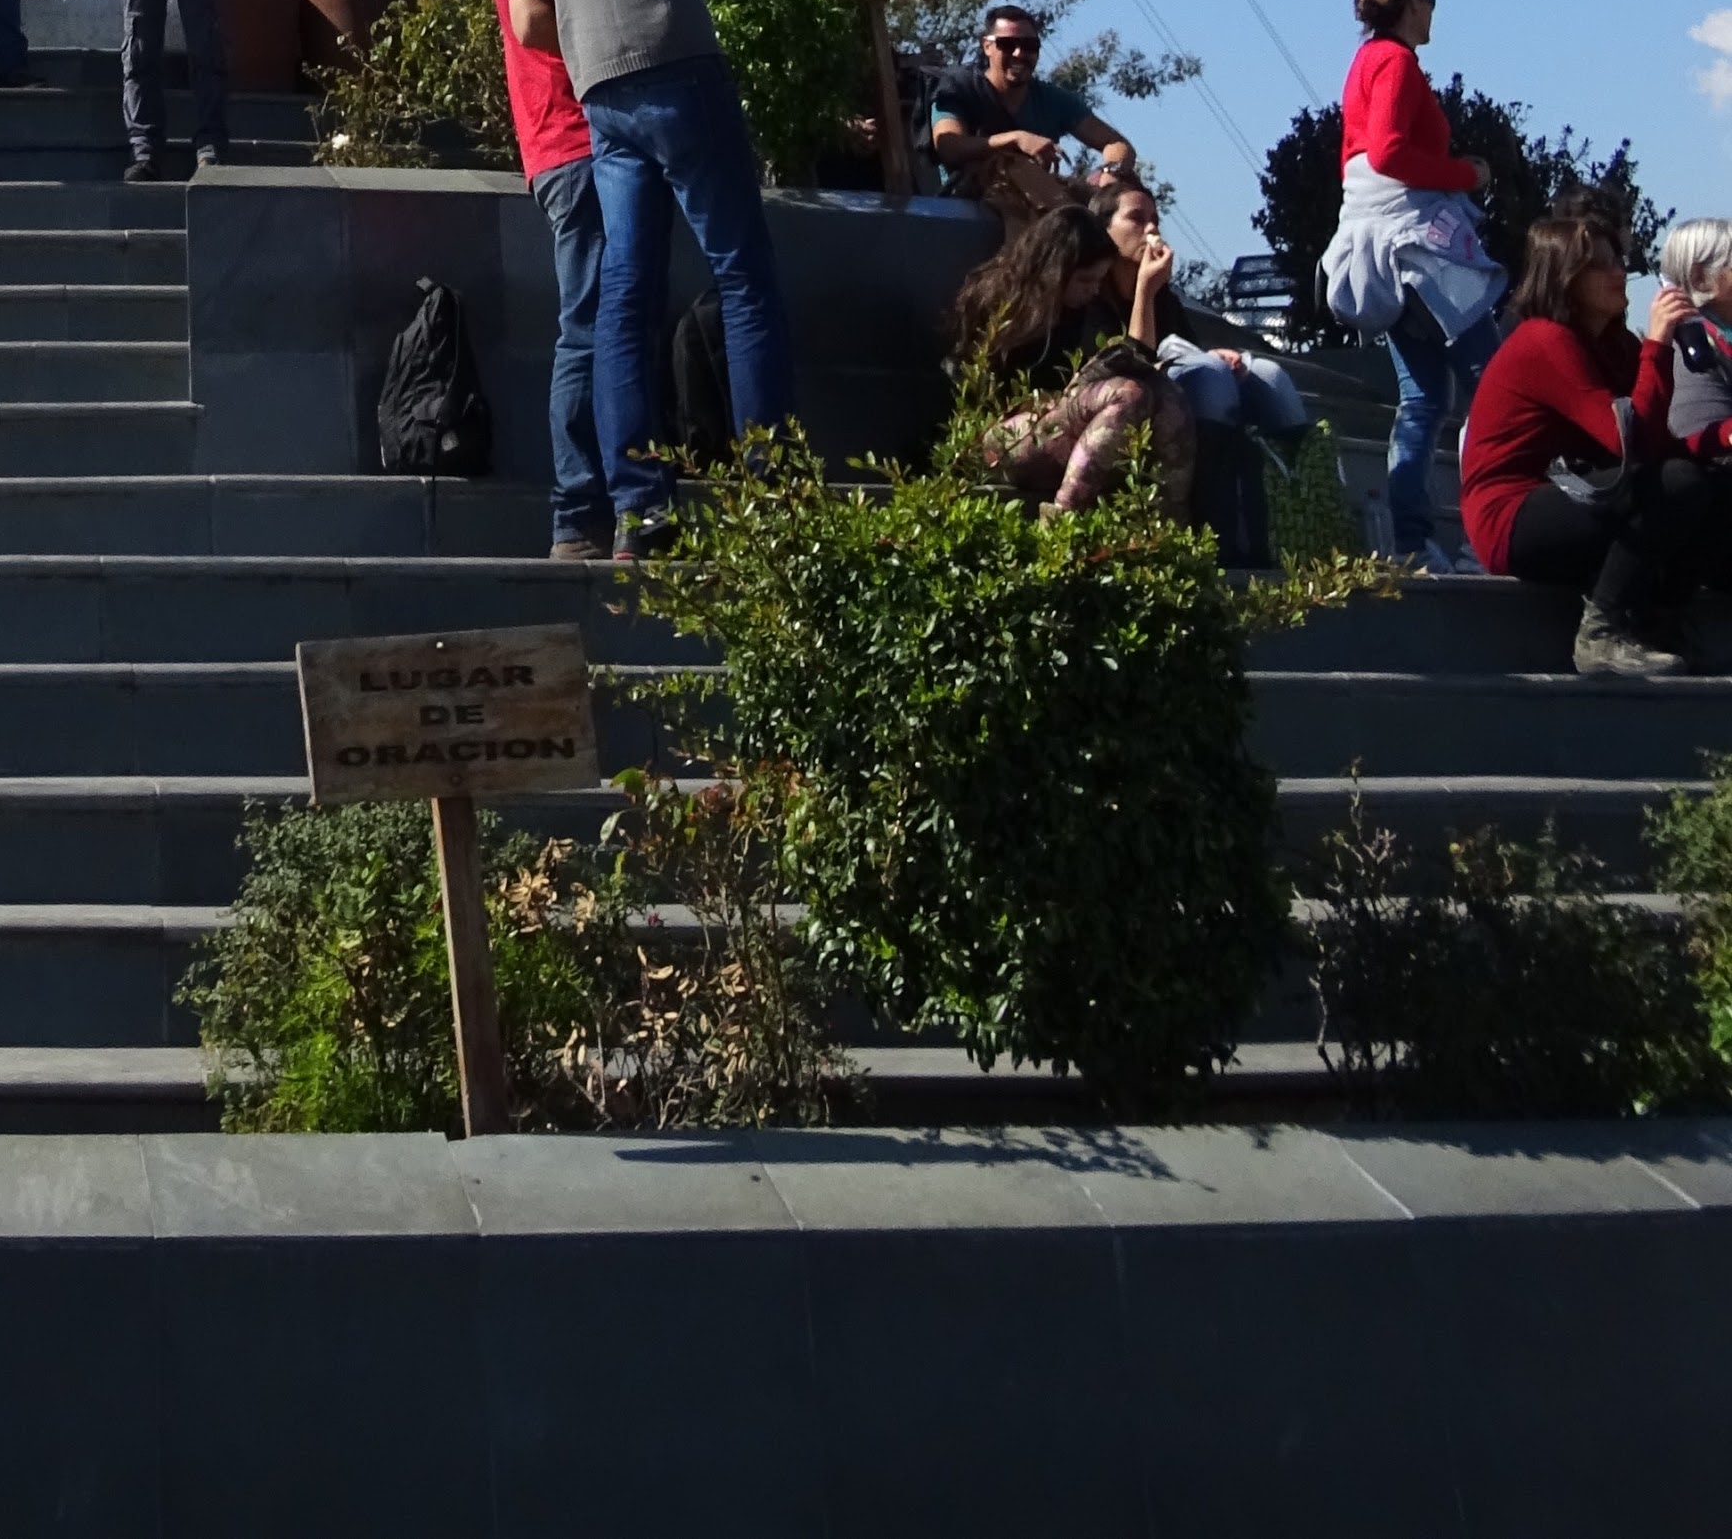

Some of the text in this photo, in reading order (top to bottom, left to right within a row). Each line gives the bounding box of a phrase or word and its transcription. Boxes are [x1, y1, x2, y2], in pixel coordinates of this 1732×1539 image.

[360, 665, 534, 692] LUGAR
[419, 704, 484, 725] DE
[336, 737, 575, 766] ORACION
